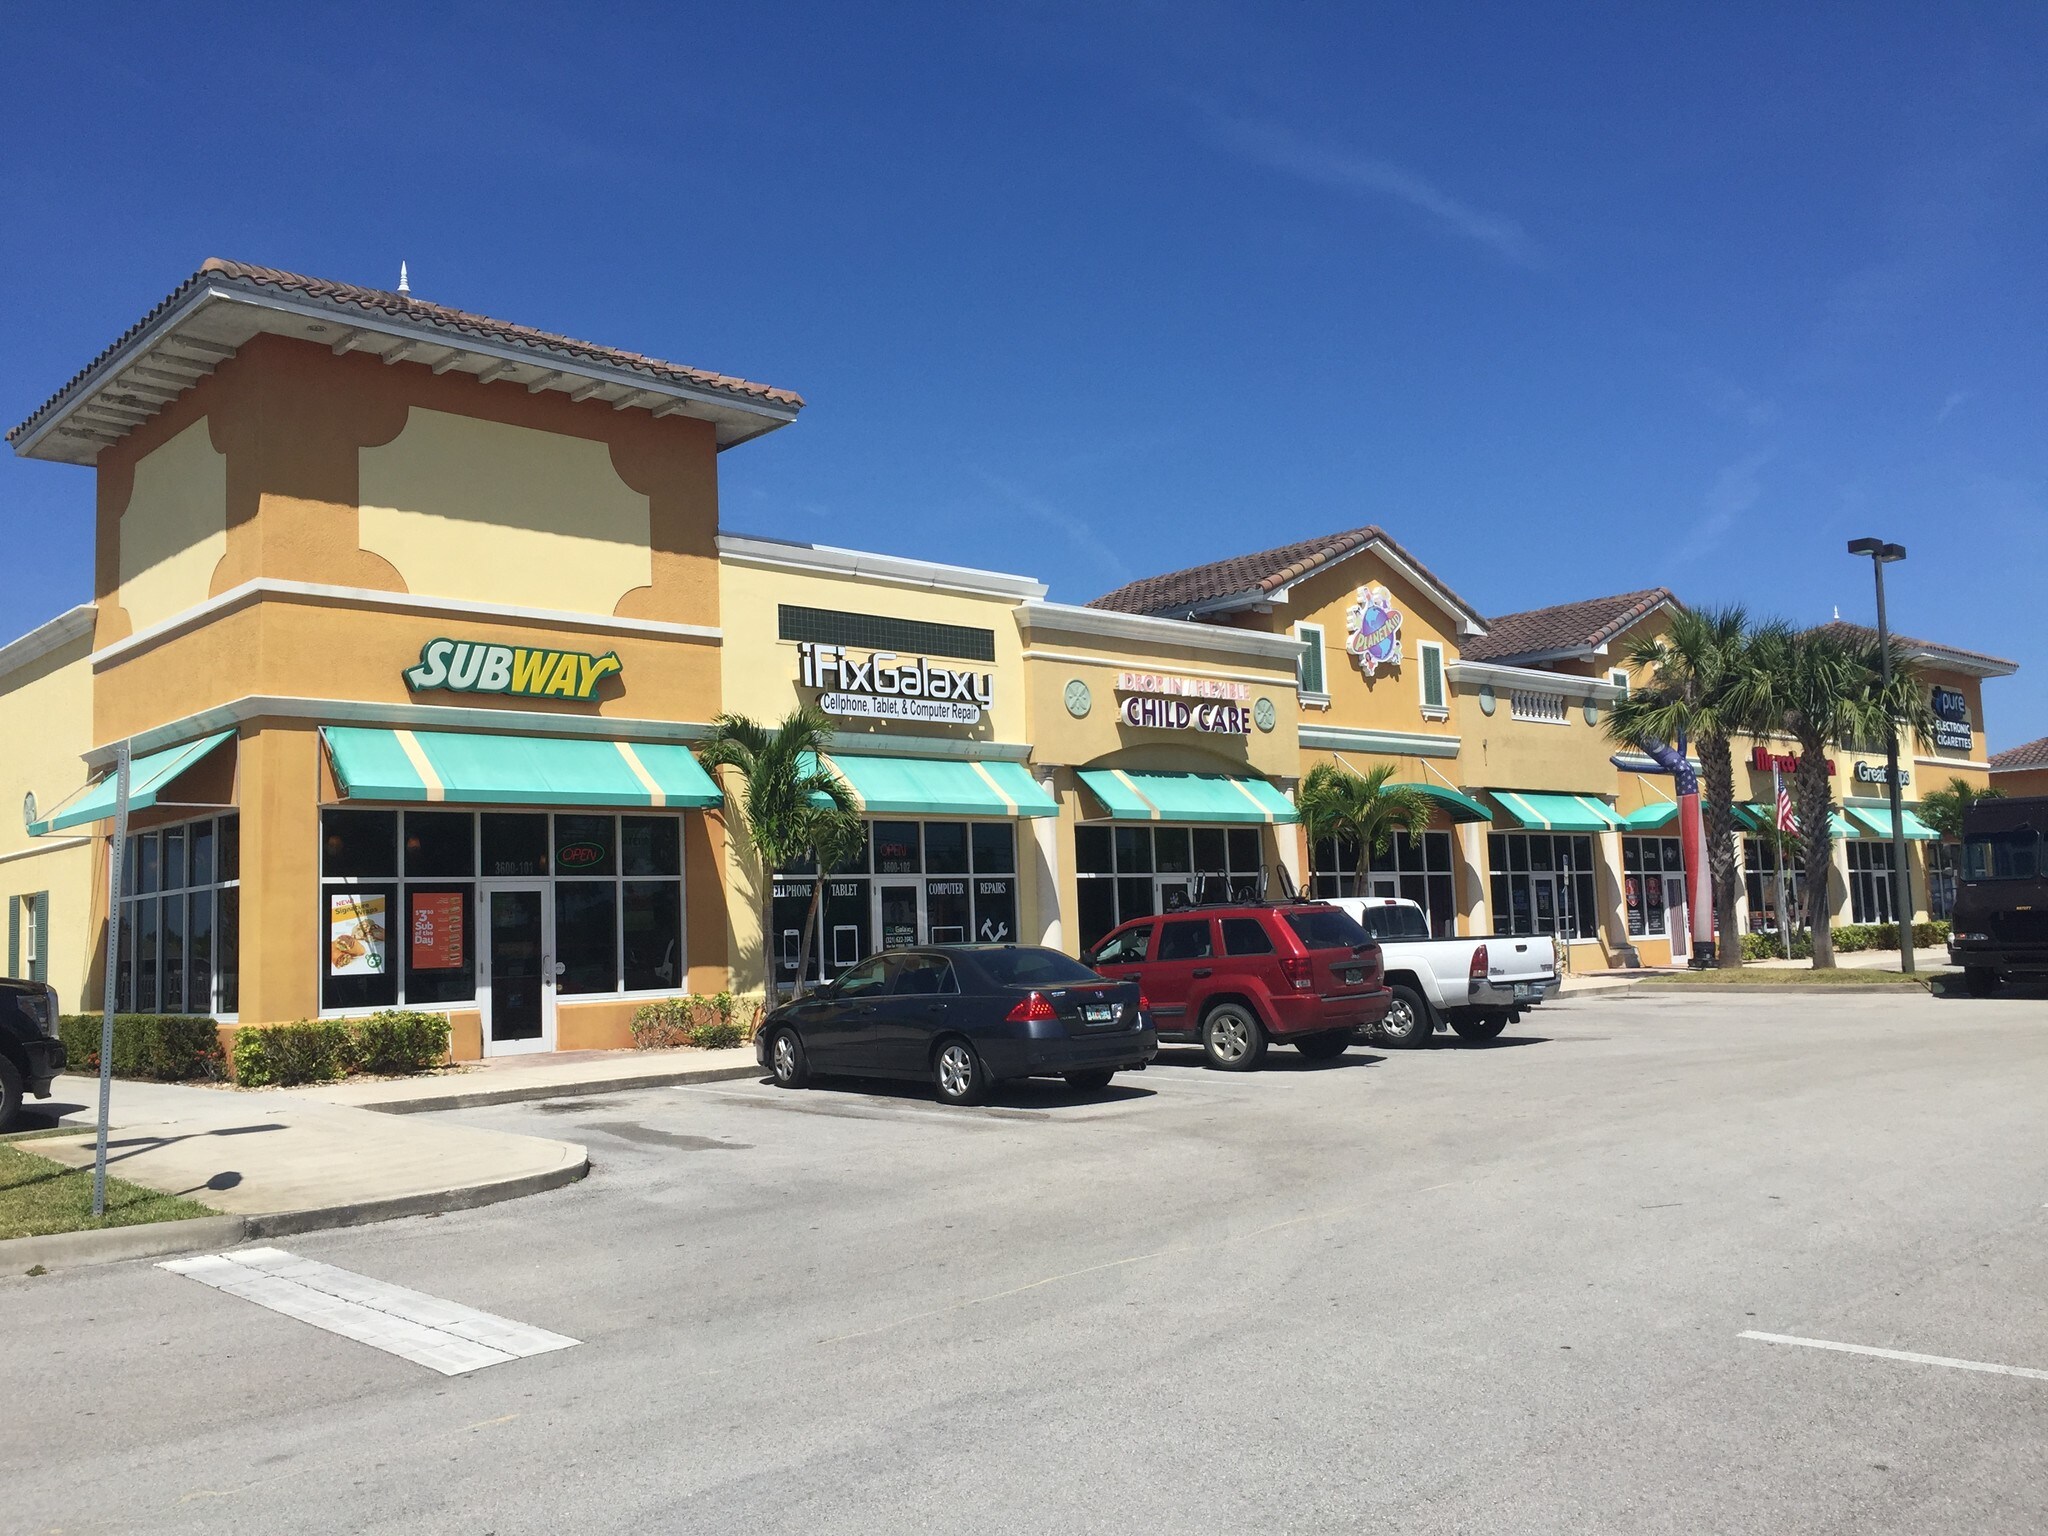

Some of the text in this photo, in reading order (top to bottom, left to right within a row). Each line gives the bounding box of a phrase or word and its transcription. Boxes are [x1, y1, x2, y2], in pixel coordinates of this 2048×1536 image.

[409, 640, 620, 698] SUBWAY
[800, 642, 993, 711] iFixGalaxy
[1124, 673, 1164, 692] DROP
[1169, 678, 1182, 695] IN
[1196, 680, 1251, 699] FLEXIBLE
[823, 693, 977, 722] Cellphone, Tablet, & Computer Repair
[1942, 693, 1965, 714] pure
[1126, 697, 1252, 733] CHILD CARE
[1936, 720, 1970, 734] ELECTRONIC
[1937, 735, 1971, 748] CIGARETTES
[1859, 762, 1887, 782] Great
[562, 848, 600, 863] OPEN
[881, 844, 907, 857] OPEN
[773, 884, 812, 897] ELLPHONE
[831, 884, 858, 896] TABLET
[929, 883, 964, 895] COMPUTER
[980, 882, 1007, 894] REPAIRS
[415, 922, 433, 931] Sub
[415, 937, 433, 946] Day
